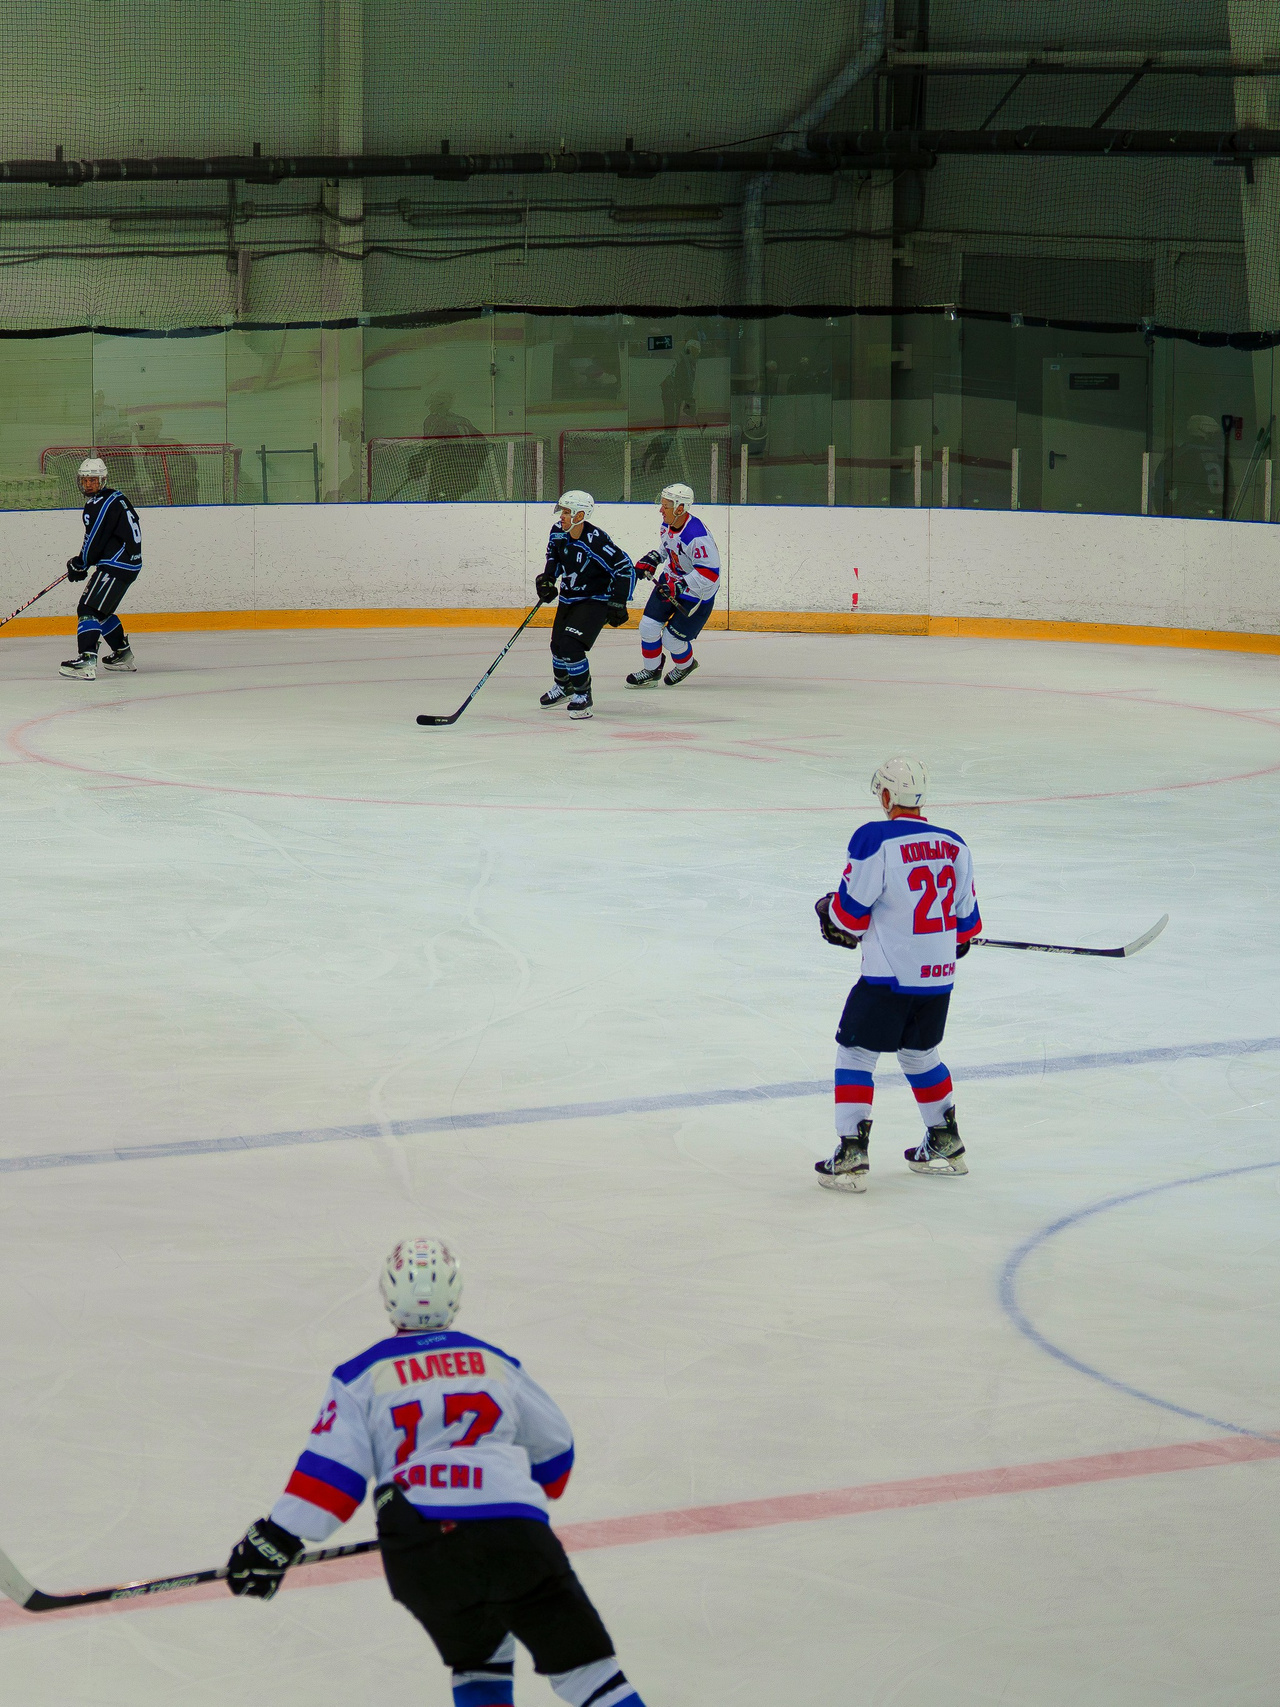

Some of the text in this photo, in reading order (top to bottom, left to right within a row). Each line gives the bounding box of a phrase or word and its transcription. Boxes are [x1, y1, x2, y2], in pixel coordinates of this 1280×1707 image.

[915, 793, 922, 804] 7
[907, 865, 957, 935] 22
[418, 1314, 431, 1325] 17
[393, 1351, 486, 1386] ГАЛЕЕВ
